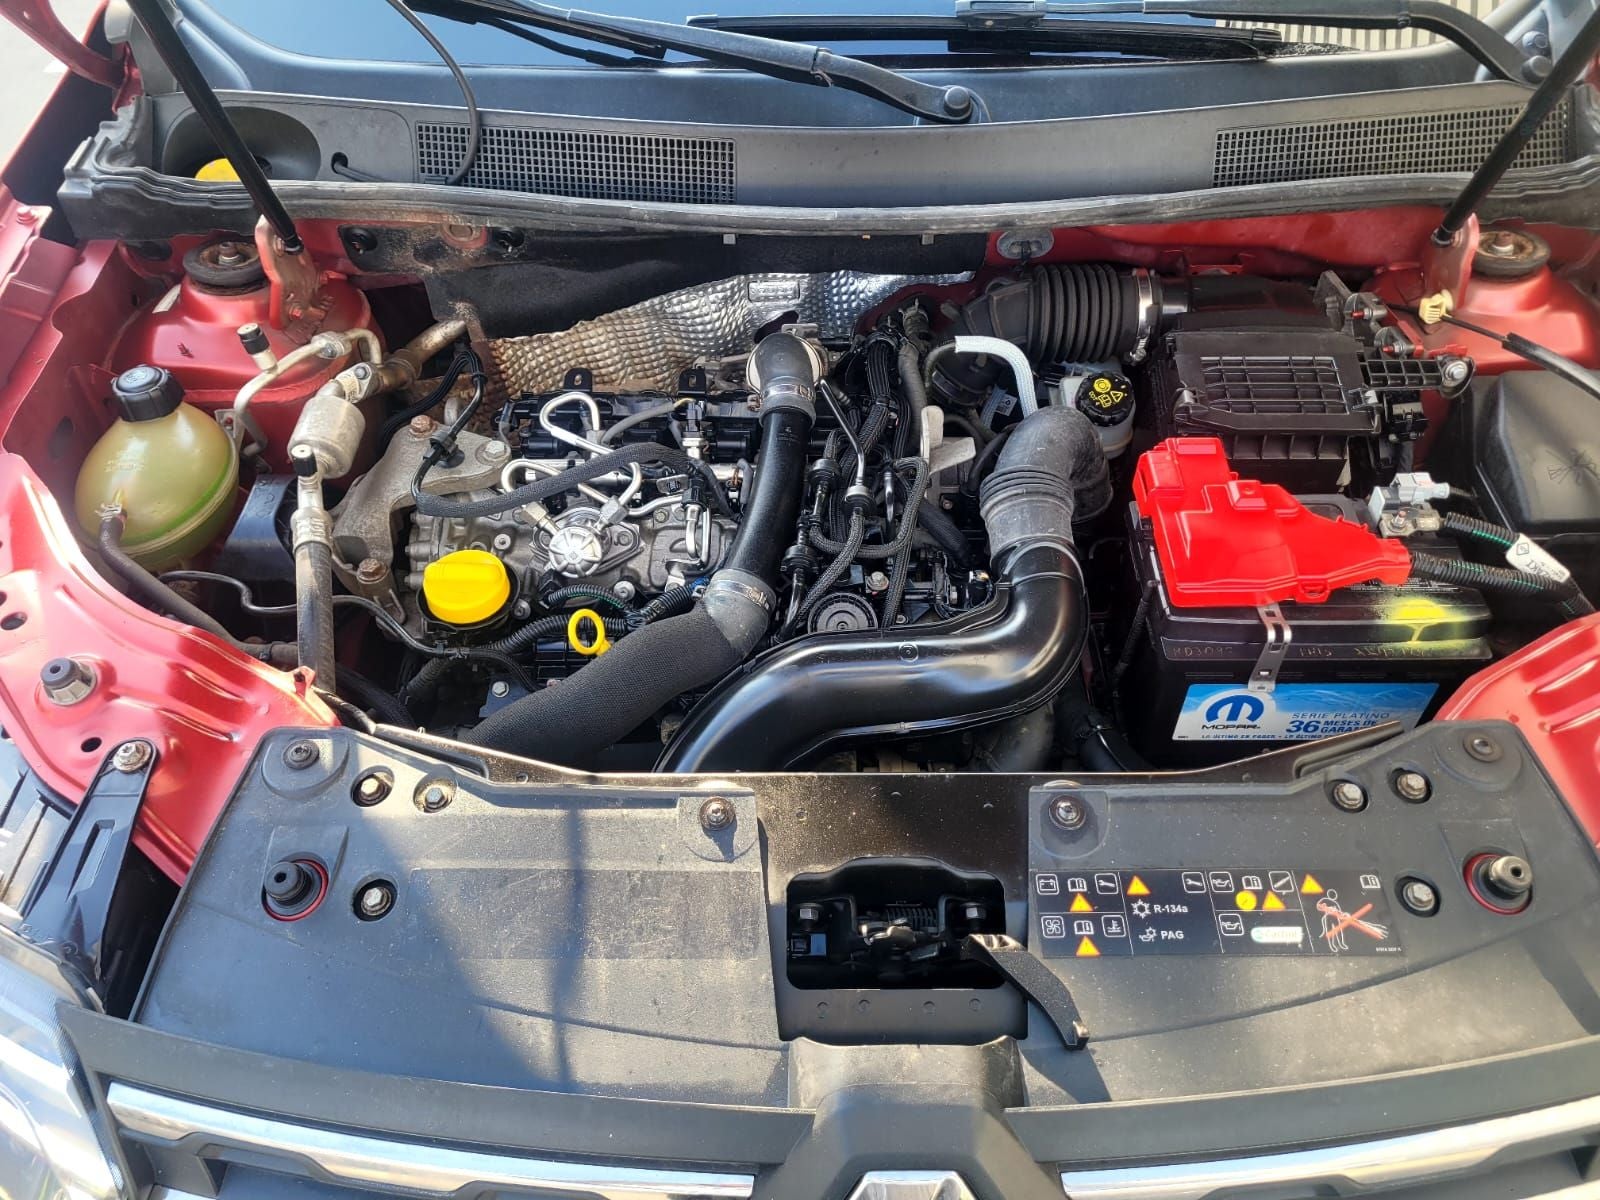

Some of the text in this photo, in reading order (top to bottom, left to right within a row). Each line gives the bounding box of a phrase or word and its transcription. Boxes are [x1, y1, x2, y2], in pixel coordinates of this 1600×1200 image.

[1334, 711, 1390, 719] PLATINO
[1286, 720, 1320, 733] 36
[1153, 904, 1189, 913] R-134a
[1160, 930, 1185, 940] PAG
